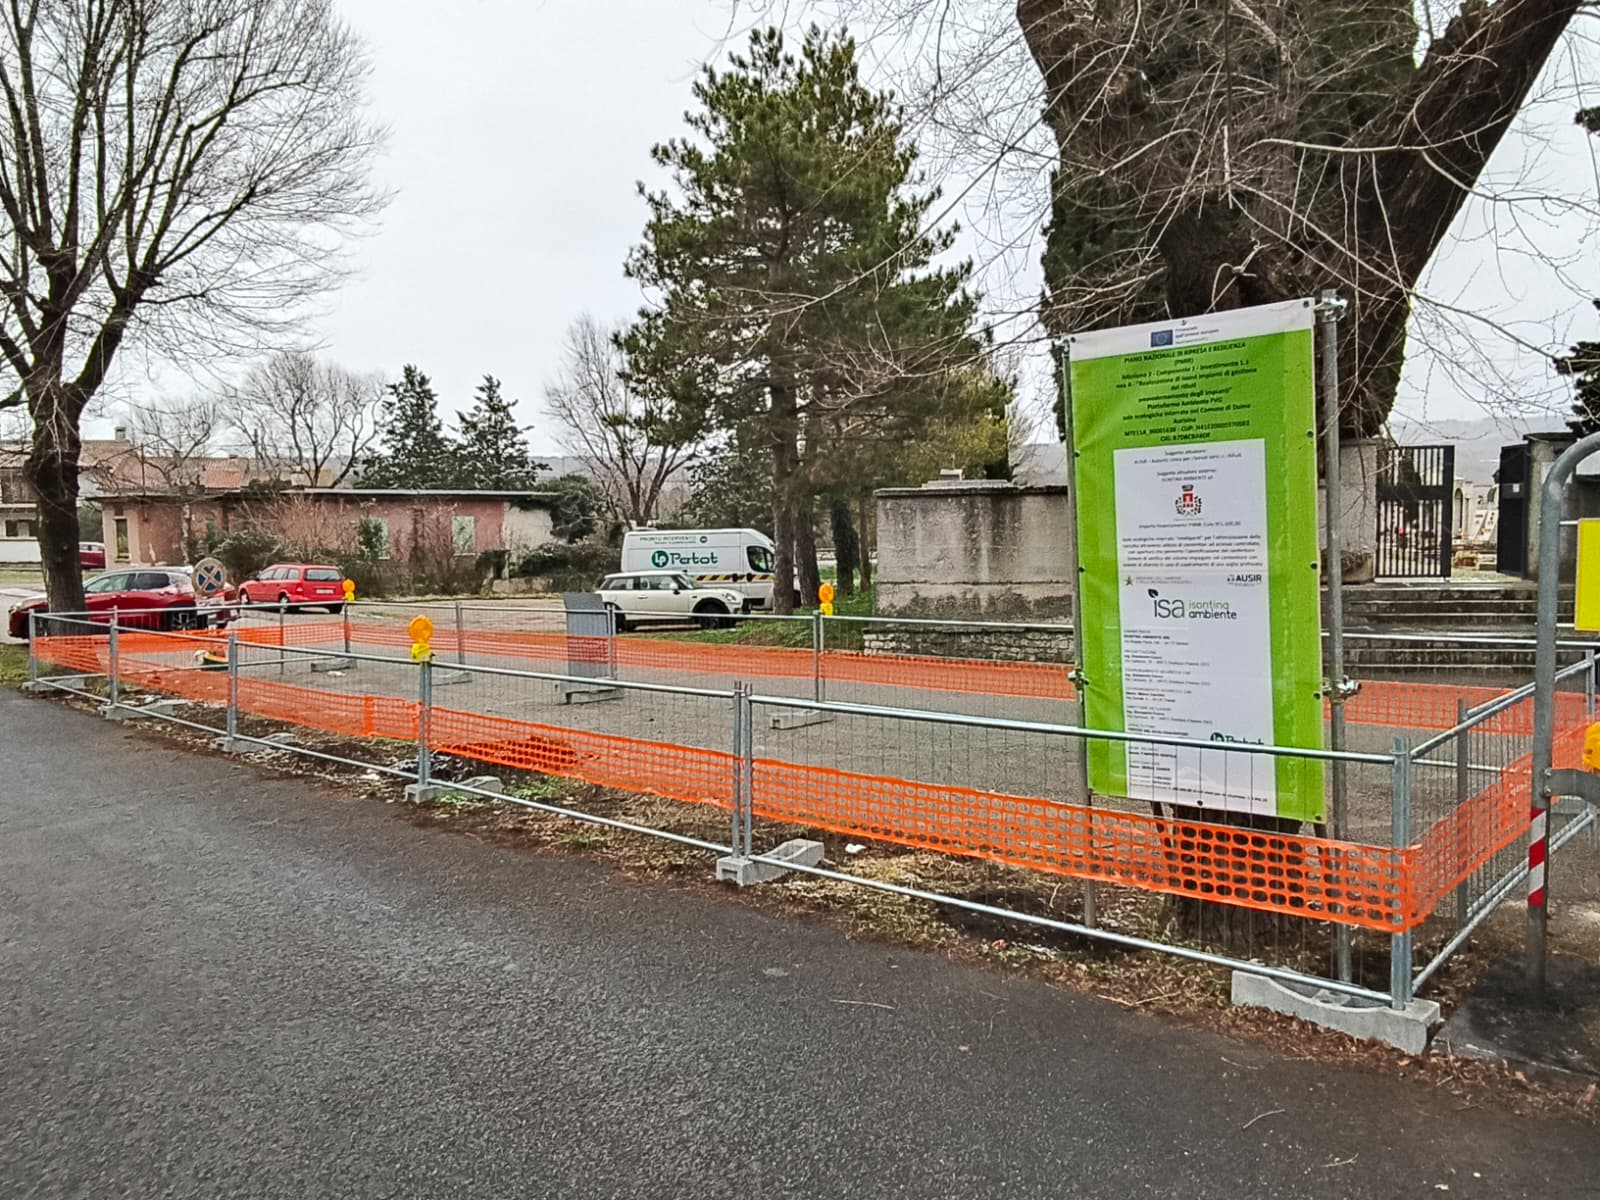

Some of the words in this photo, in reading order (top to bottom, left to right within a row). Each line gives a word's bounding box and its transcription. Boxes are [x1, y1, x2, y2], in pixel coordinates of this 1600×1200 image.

[1144, 352, 1175, 361] NAZIONALE
[670, 552, 718, 565] Patot
[1236, 574, 1262, 582] AUSIR
[1188, 610, 1237, 620] ambiente
